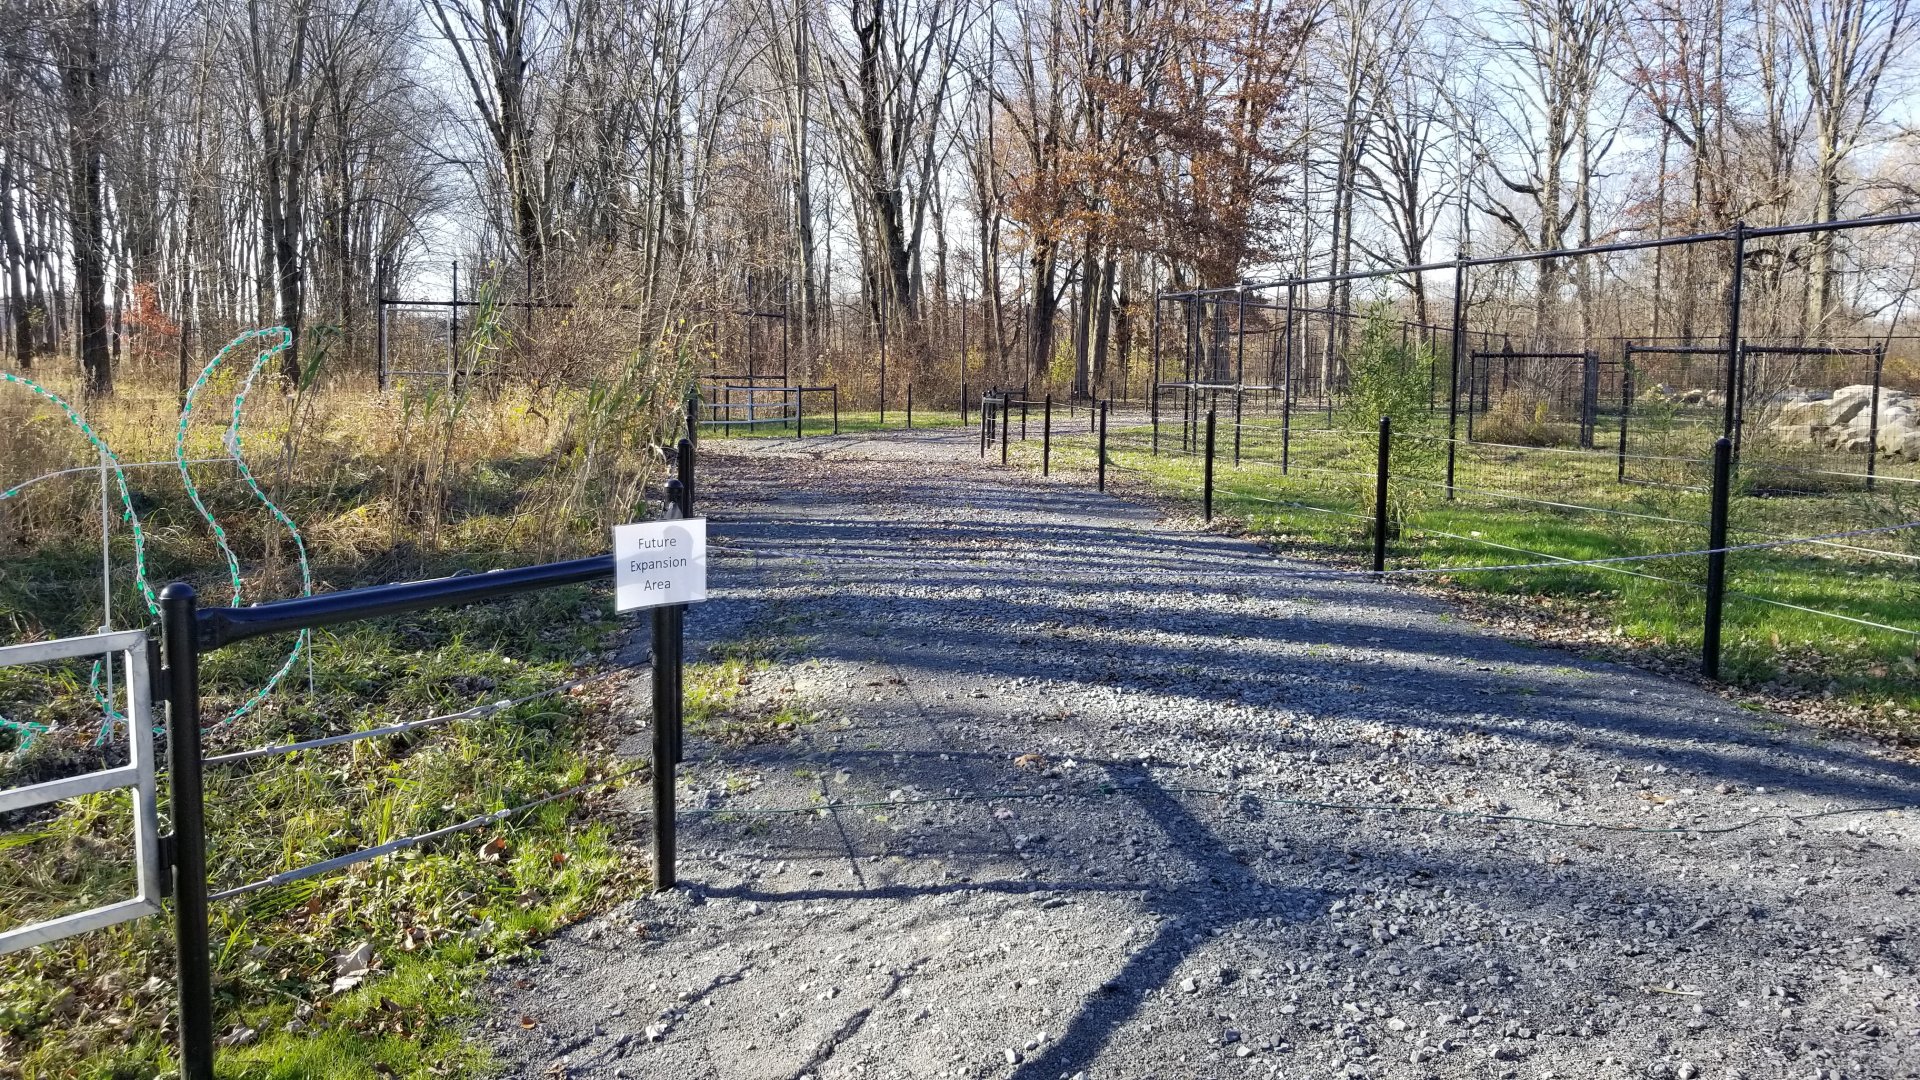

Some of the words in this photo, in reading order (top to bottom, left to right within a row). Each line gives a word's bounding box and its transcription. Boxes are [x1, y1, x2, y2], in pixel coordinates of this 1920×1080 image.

[638, 538, 677, 549] Future
[630, 557, 687, 573] Expansion
[644, 580, 671, 591] Area
